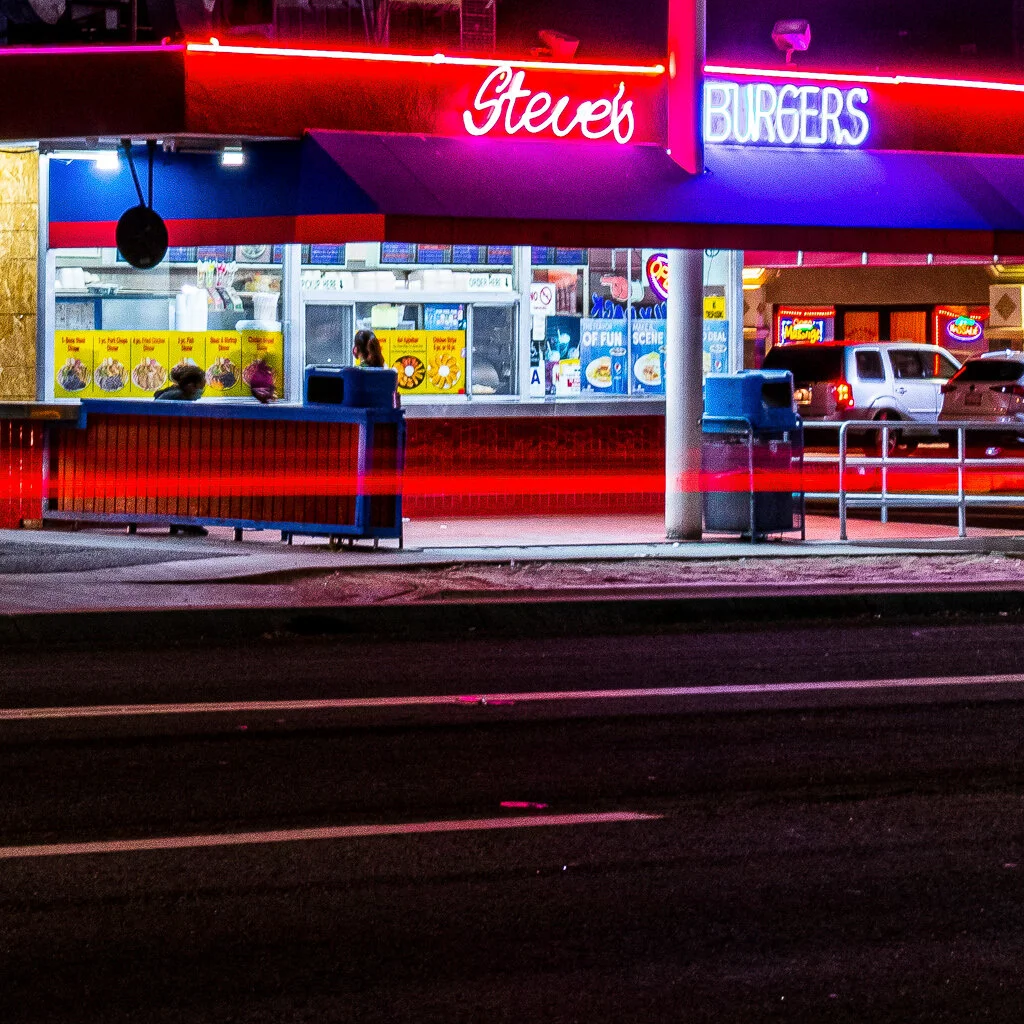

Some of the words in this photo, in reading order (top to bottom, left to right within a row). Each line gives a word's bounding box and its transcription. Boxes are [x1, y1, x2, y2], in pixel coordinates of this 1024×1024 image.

[462, 65, 635, 144] Steve's
[704, 82, 870, 146] BURGERS
[583, 331, 599, 346] OF
[600, 331, 623, 347] FUN
[632, 331, 664, 345] SCENE
[530, 369, 541, 385] A
